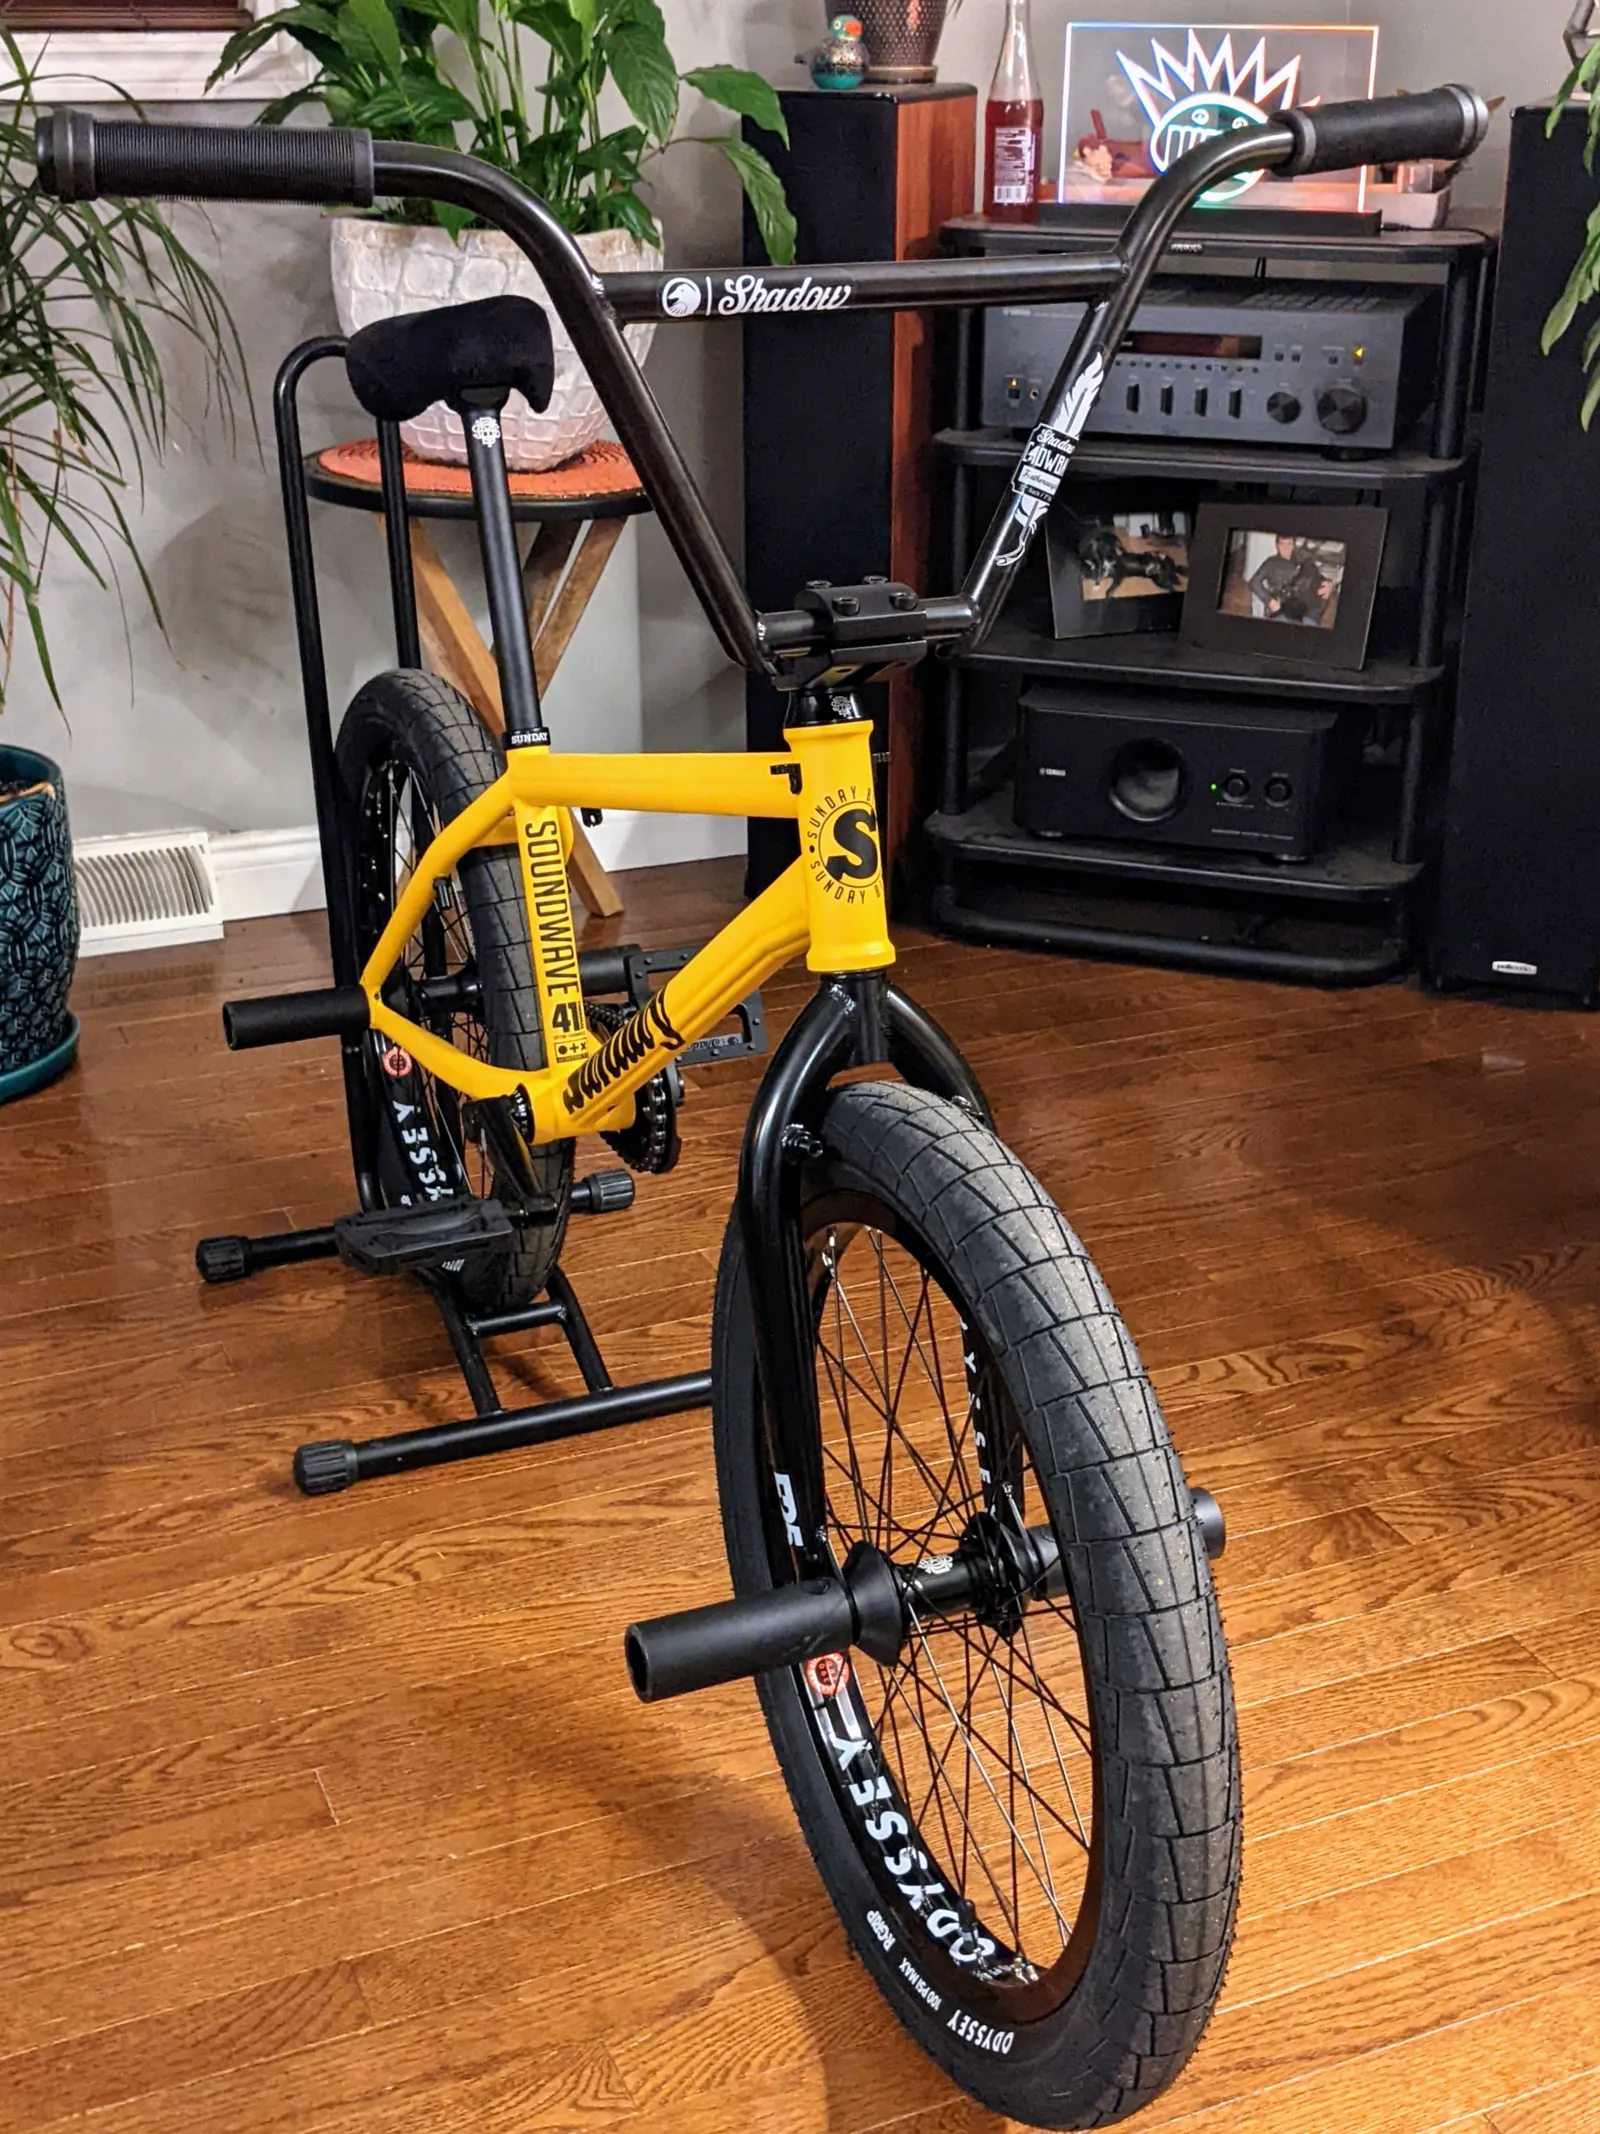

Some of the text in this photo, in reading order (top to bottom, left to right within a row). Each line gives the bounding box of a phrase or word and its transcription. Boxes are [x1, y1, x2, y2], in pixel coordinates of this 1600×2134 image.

[717, 274, 850, 316] Shadow
[511, 731, 548, 745] SUNDAY
[807, 785, 857, 839] SUNDAY
[810, 860, 866, 904] SUNDAY
[525, 820, 579, 998] SOUNDWAVE
[552, 1001, 580, 1033] 41
[829, 1731, 996, 1963] ODYSSEY
[898, 1956, 921, 1986] MAX
[915, 1977, 931, 1998] PSI
[926, 1992, 943, 2012] 100
[946, 2009, 1015, 2055] ODYSSEY
